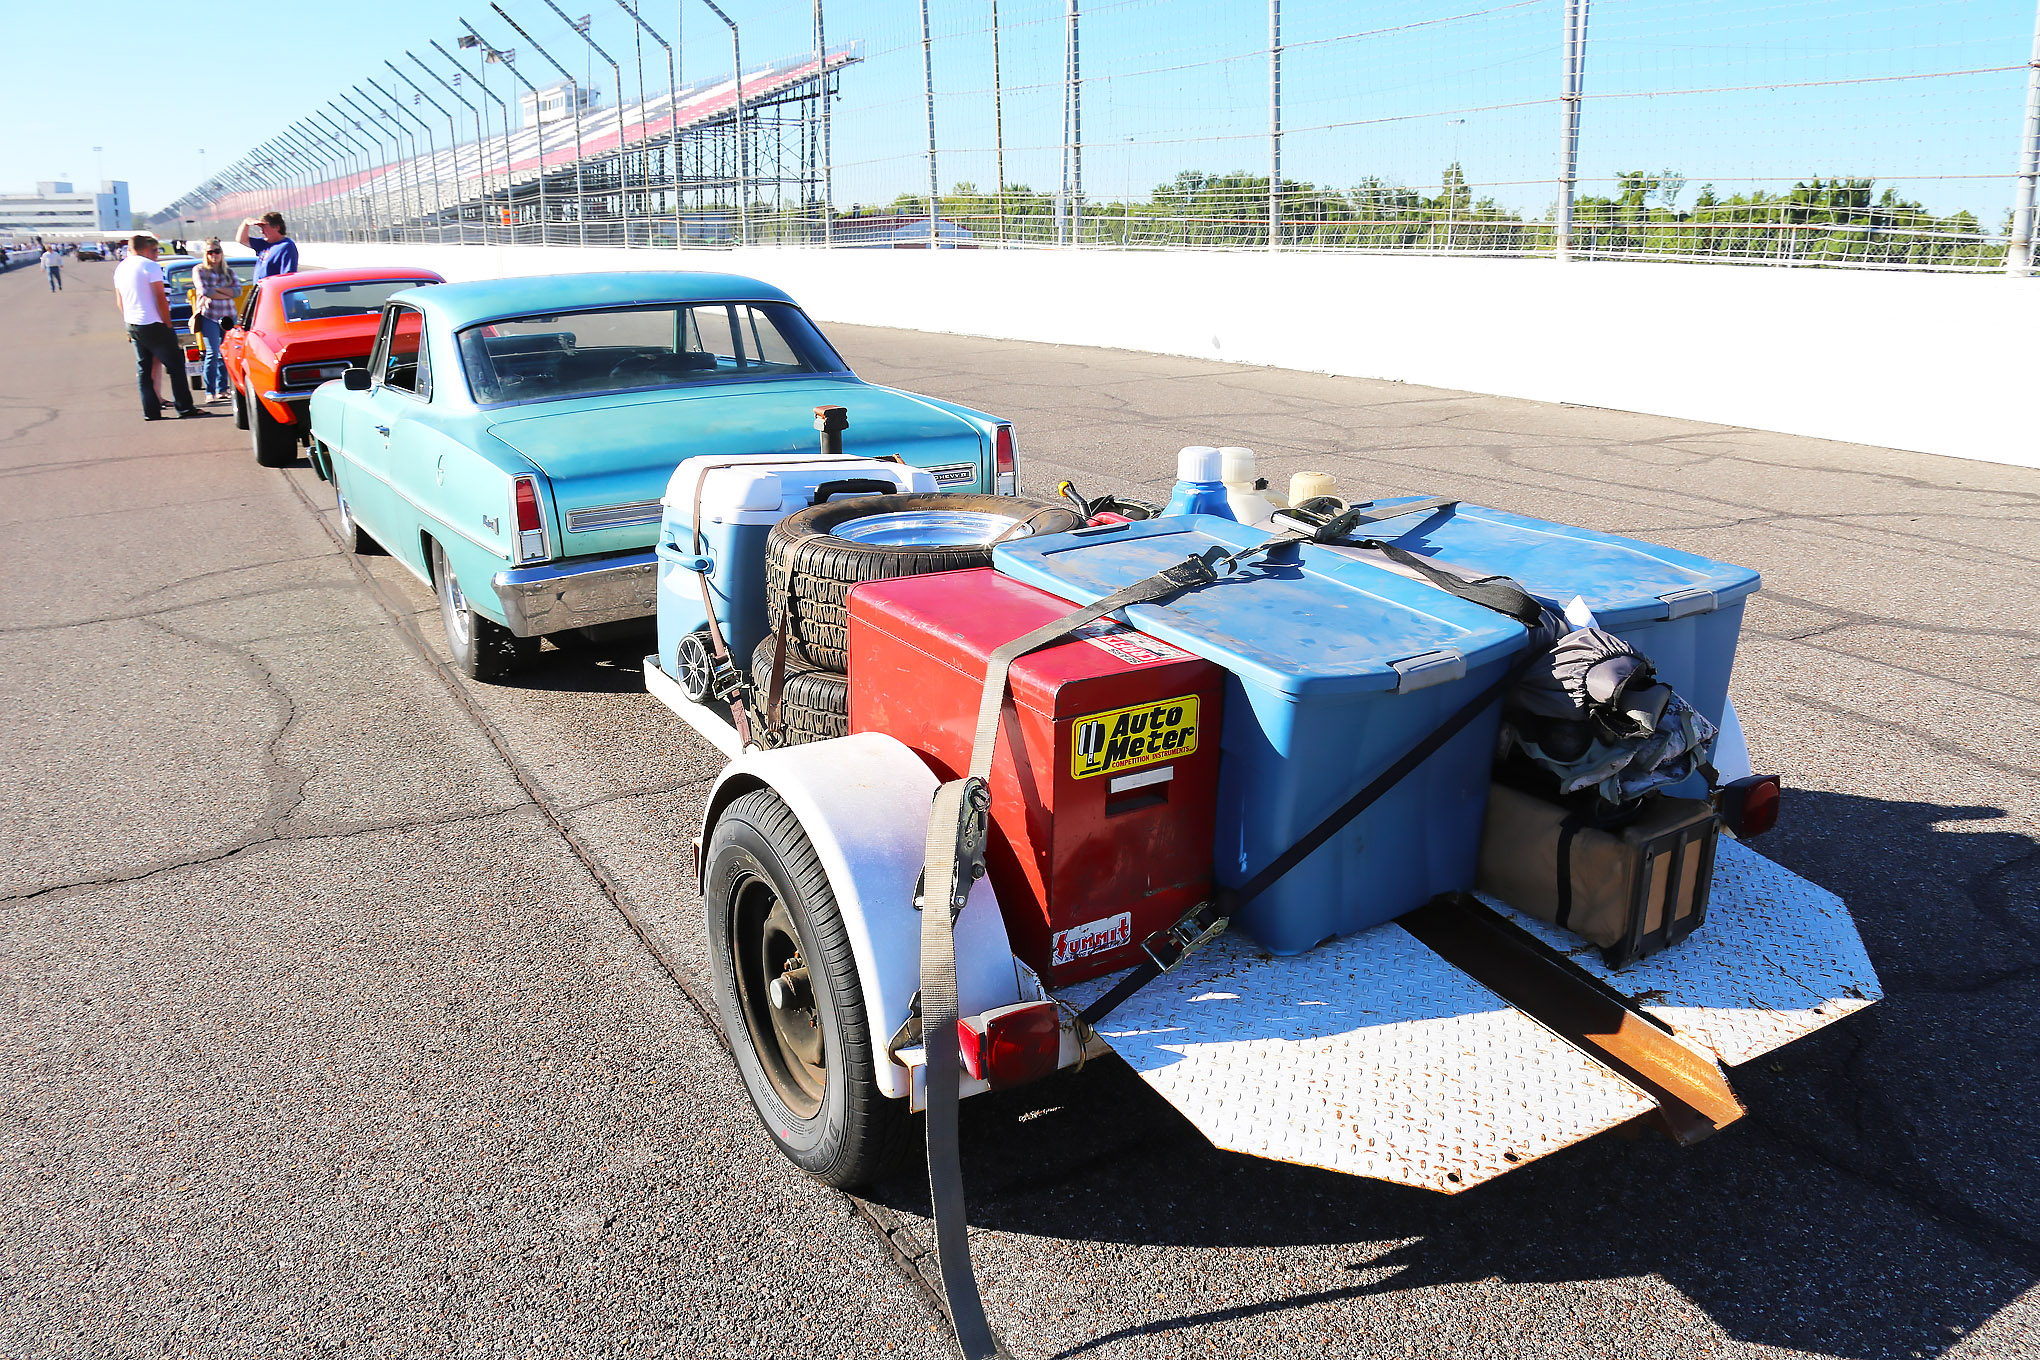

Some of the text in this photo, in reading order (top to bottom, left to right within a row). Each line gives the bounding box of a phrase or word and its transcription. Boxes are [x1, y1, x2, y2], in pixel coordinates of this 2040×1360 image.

[1111, 706, 1184, 739] Auto
[1102, 726, 1195, 771] Meter
[1111, 746, 1190, 769] COMPETITION INSTRUMENTS
